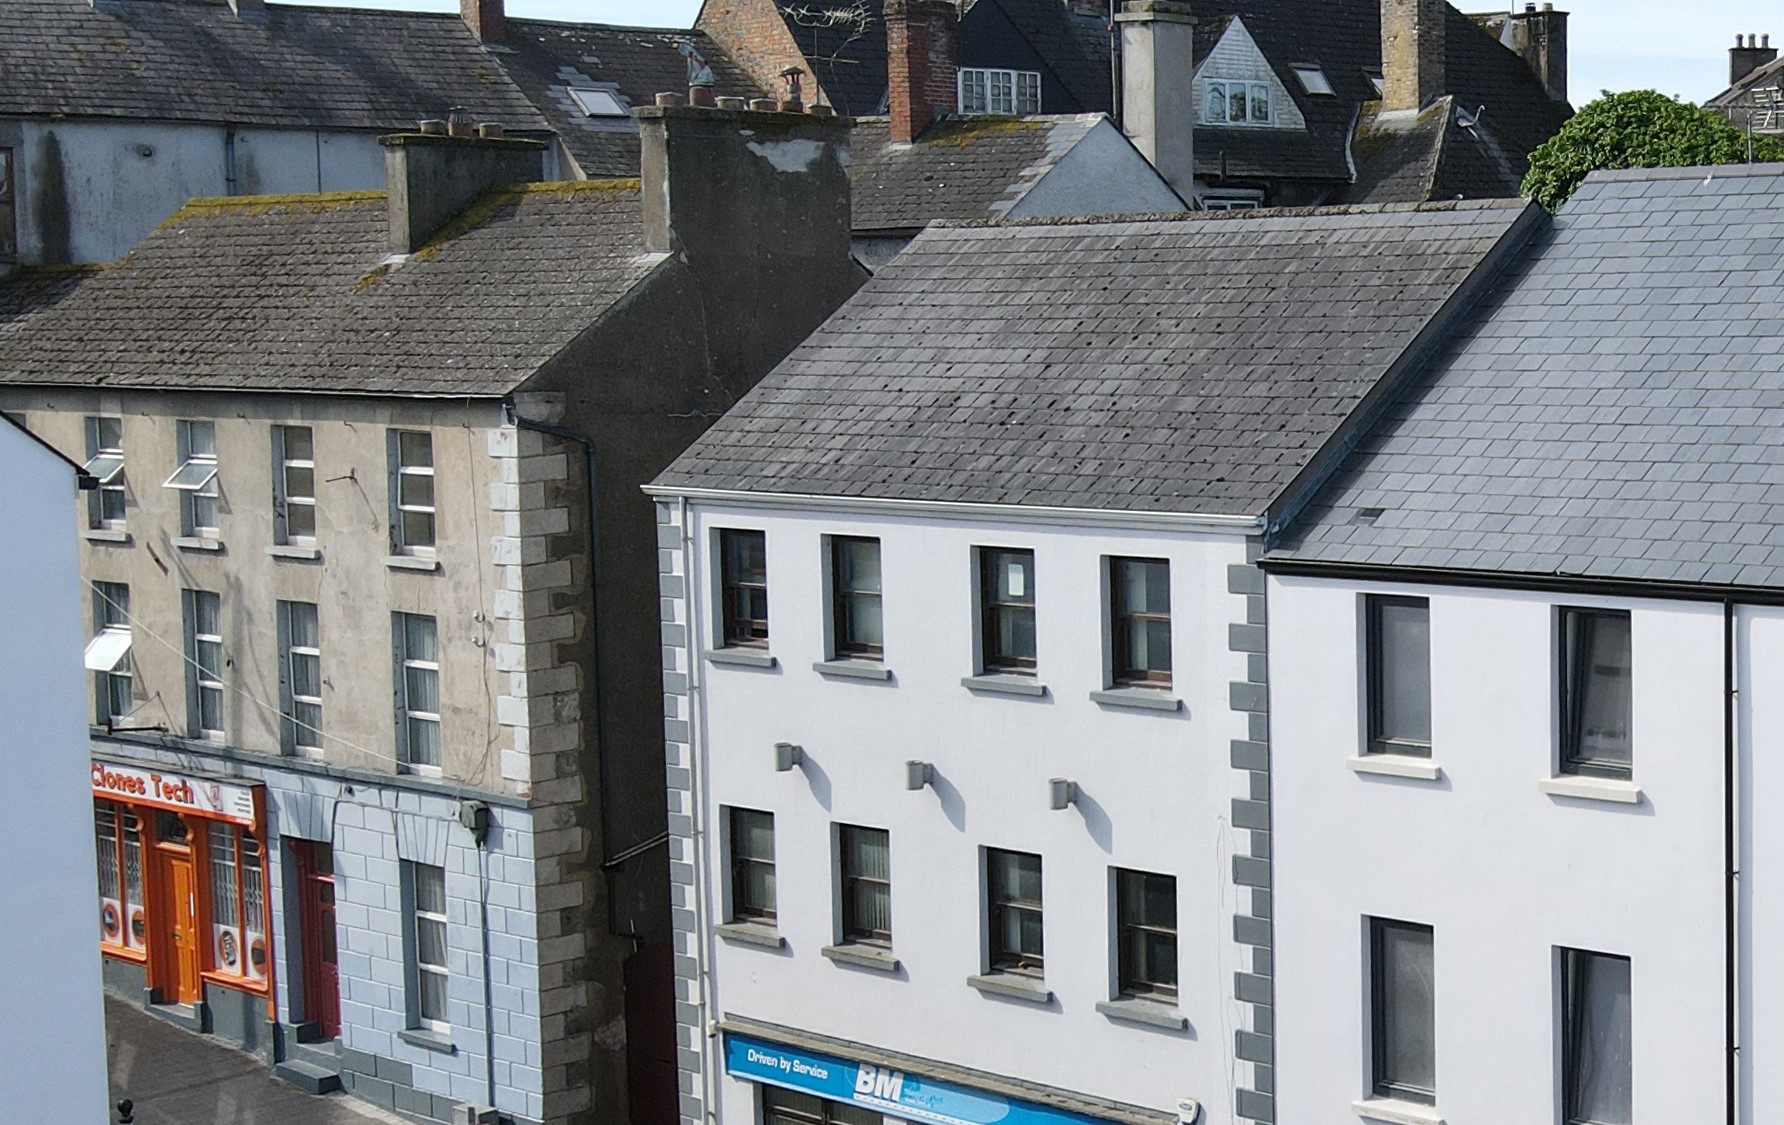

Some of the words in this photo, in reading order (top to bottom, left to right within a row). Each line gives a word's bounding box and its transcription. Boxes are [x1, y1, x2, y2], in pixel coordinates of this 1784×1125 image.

[91, 762, 146, 795] Clones
[151, 773, 195, 804] Tech
[747, 1049, 778, 1067] Driven
[780, 1057, 791, 1074] by
[793, 1060, 828, 1080] Service
